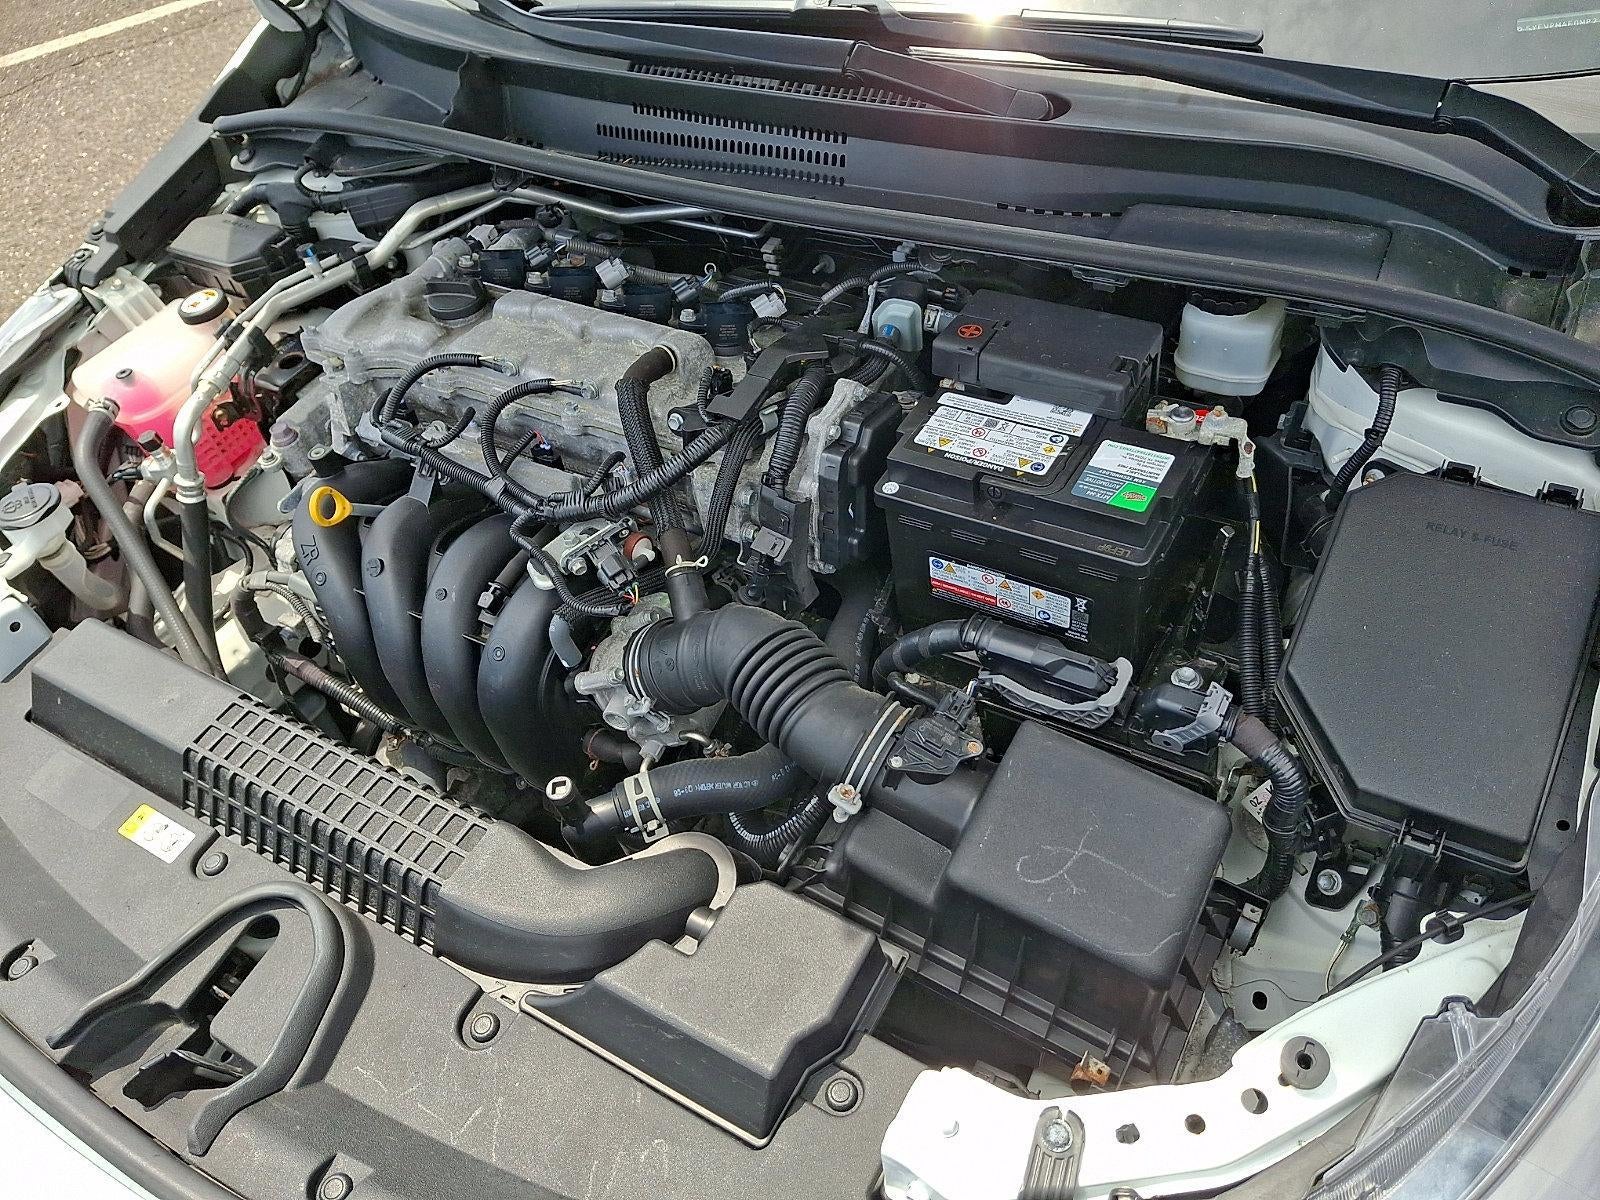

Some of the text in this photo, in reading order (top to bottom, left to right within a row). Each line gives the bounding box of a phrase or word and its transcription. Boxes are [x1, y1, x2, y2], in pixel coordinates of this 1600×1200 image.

[943, 451, 1004, 472] DANGER/POISON
[1099, 469, 1132, 480] TECHNOLOGY
[1084, 476, 1121, 489] AUTOMOTIVE
[1425, 521, 1467, 538] RELAY
